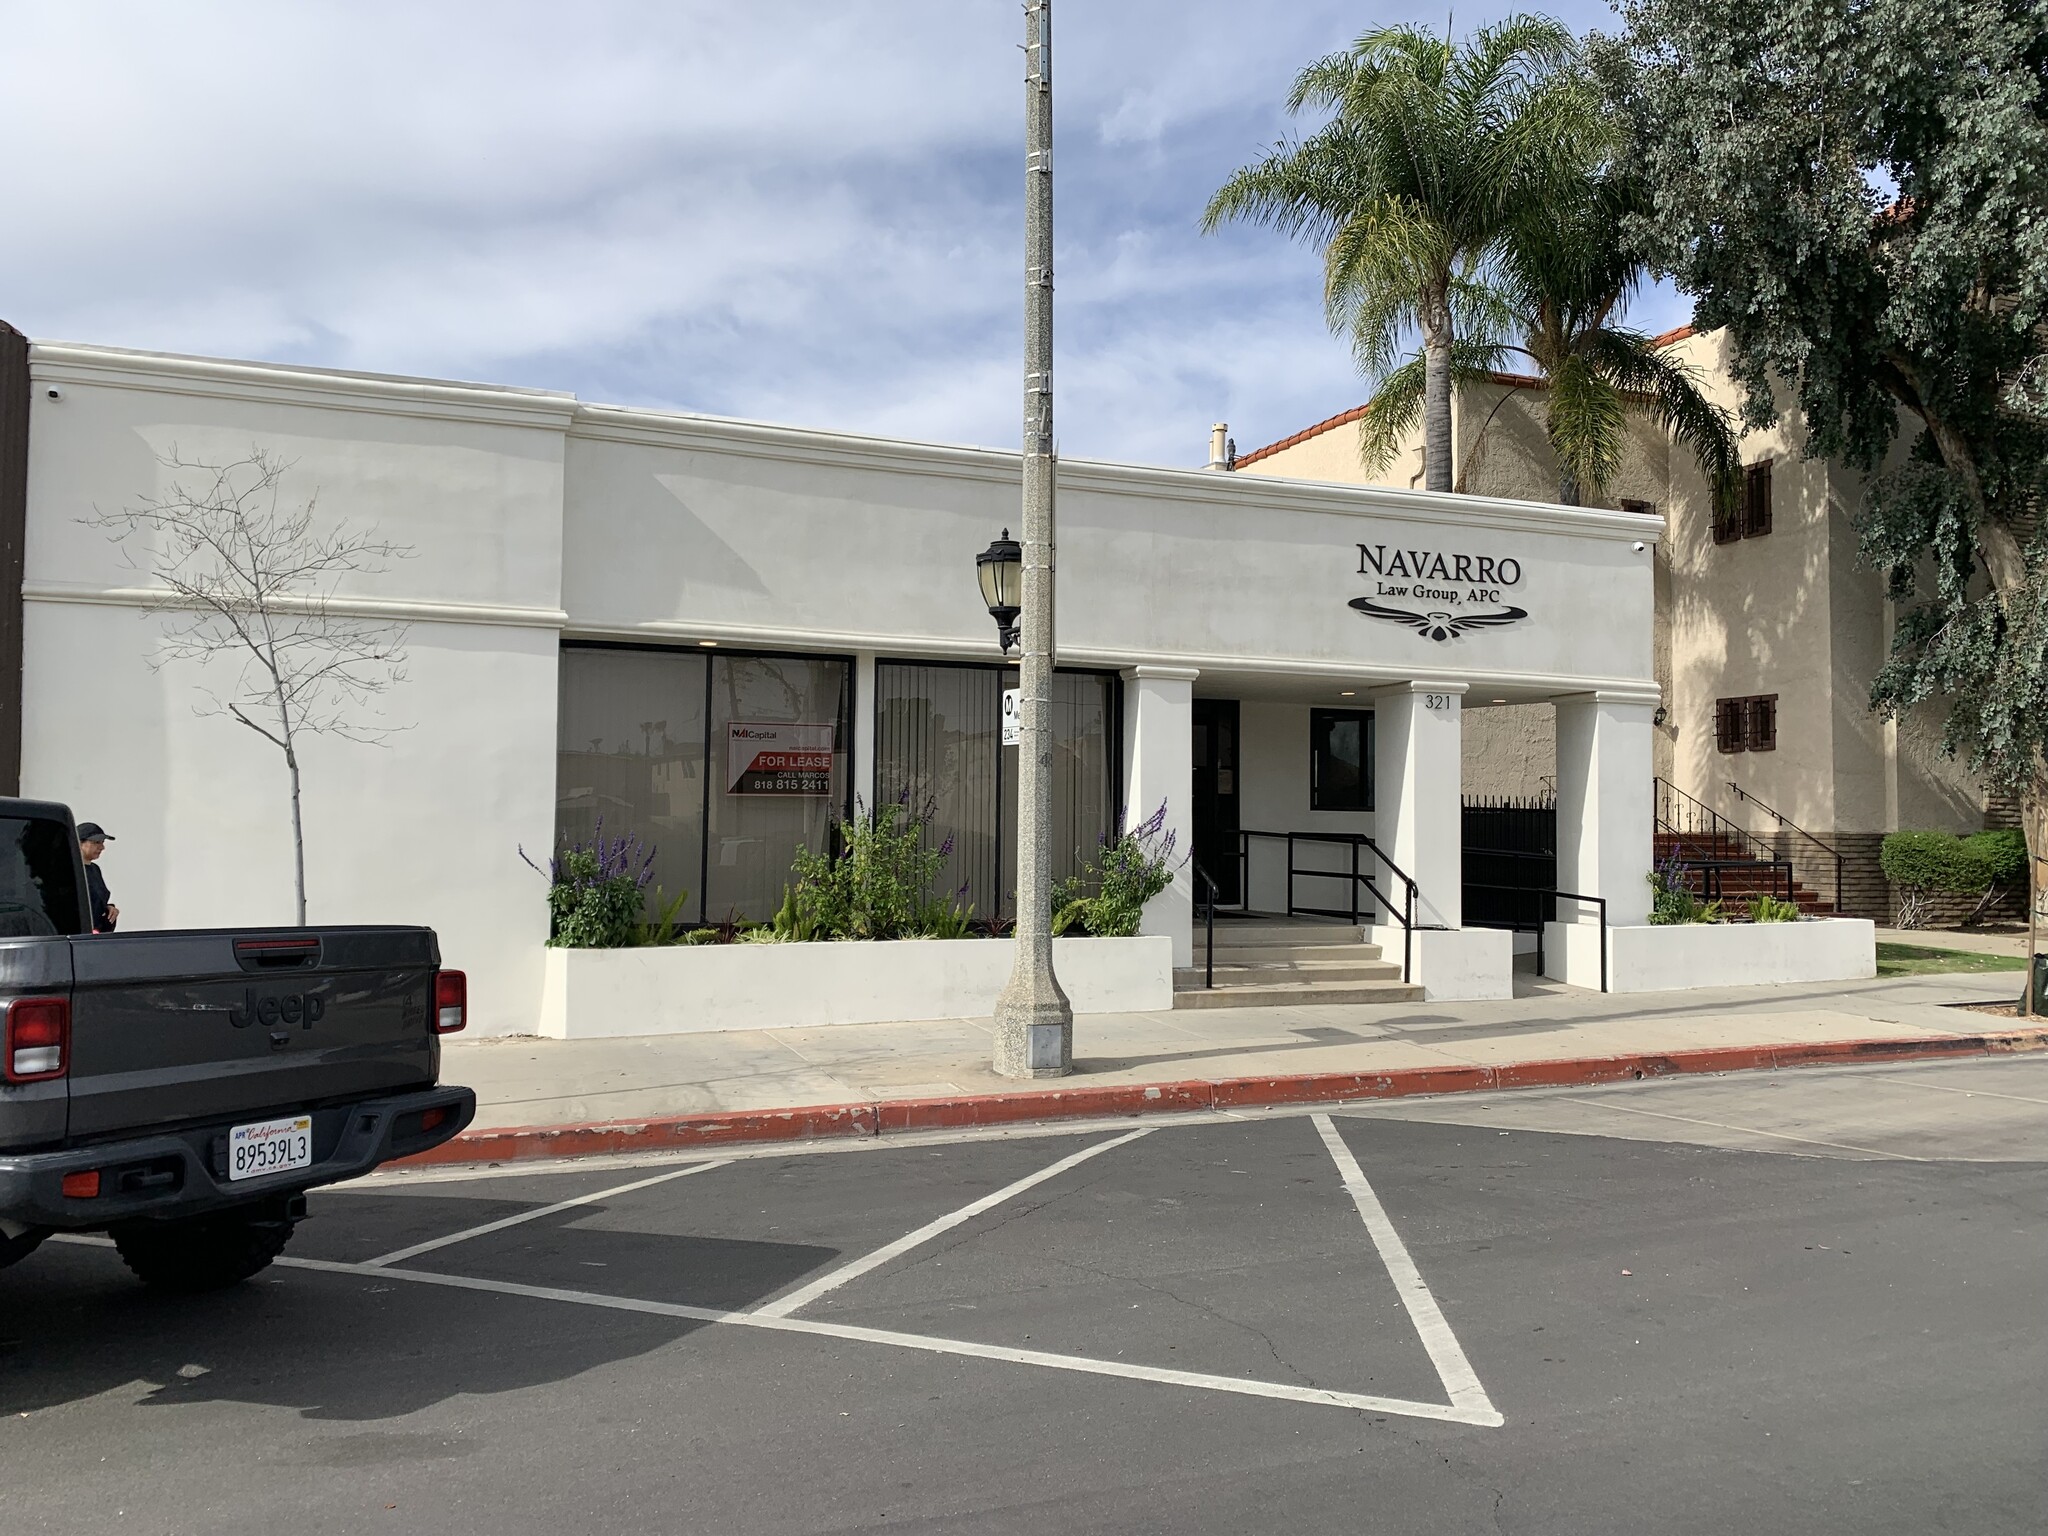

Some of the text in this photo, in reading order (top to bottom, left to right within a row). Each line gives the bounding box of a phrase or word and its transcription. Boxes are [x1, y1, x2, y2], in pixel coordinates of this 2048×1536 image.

[1355, 543, 1521, 585] NAVARRO
[1377, 582, 1500, 605] Law Group, APC
[1425, 694, 1450, 710] 321
[1004, 729, 1013, 740] 234
[759, 756, 830, 768] FOR LEASE
[777, 771, 796, 779] CALL
[754, 780, 829, 790] 818 815 2411
[229, 987, 326, 1030] Jeep
[234, 1130, 246, 1141] APR
[247, 1124, 297, 1142] California
[236, 1136, 307, 1171] 89539L3
[250, 1163, 292, 1174] dmv.ca.gov
